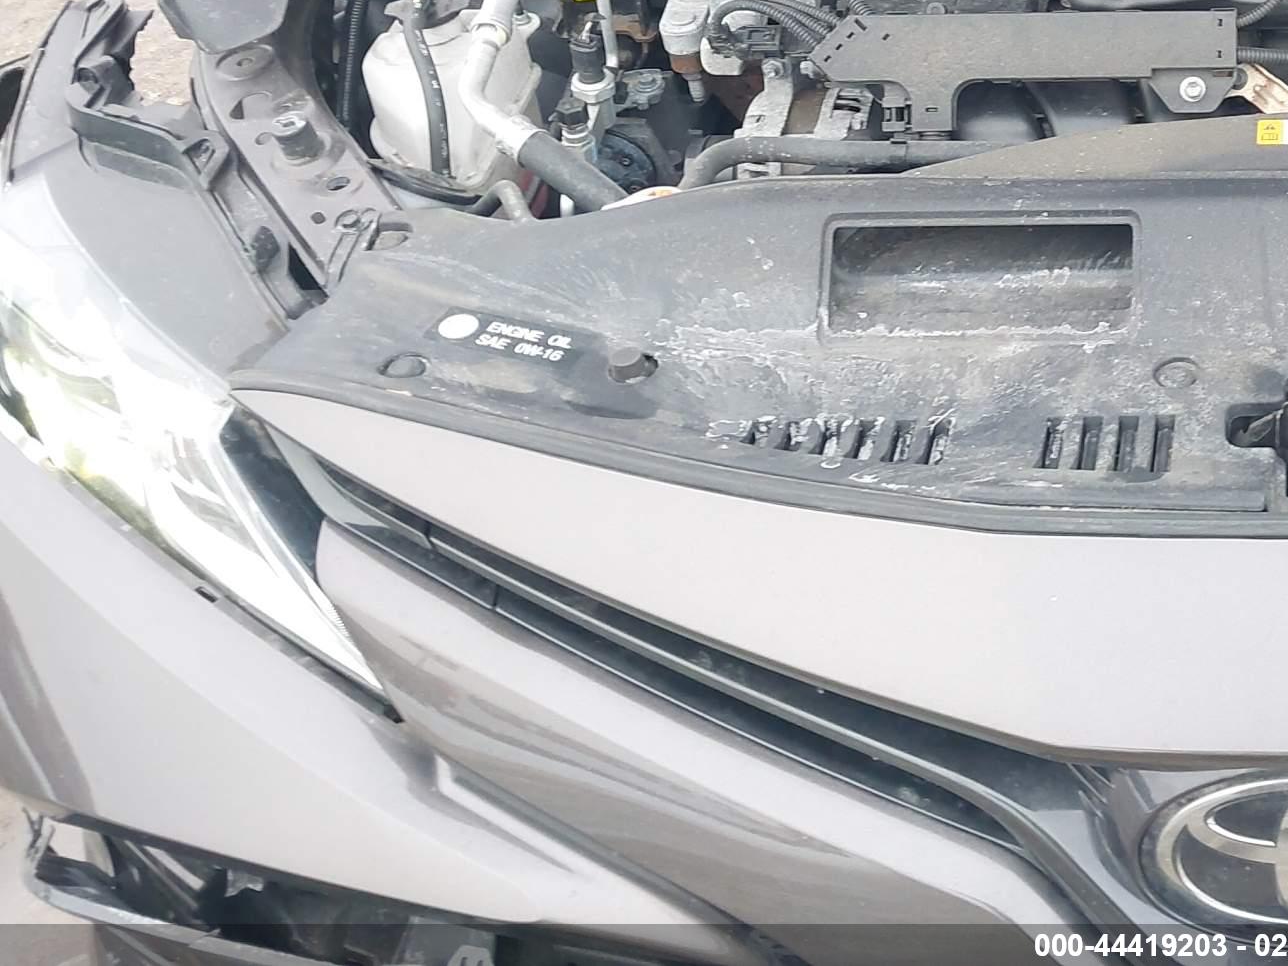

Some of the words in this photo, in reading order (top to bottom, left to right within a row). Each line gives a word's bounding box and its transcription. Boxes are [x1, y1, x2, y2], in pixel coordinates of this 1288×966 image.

[475, 334, 511, 350] SAE
[514, 342, 565, 362] 0W-16
[486, 321, 545, 342] ENGINE
[547, 335, 572, 349] OIL
